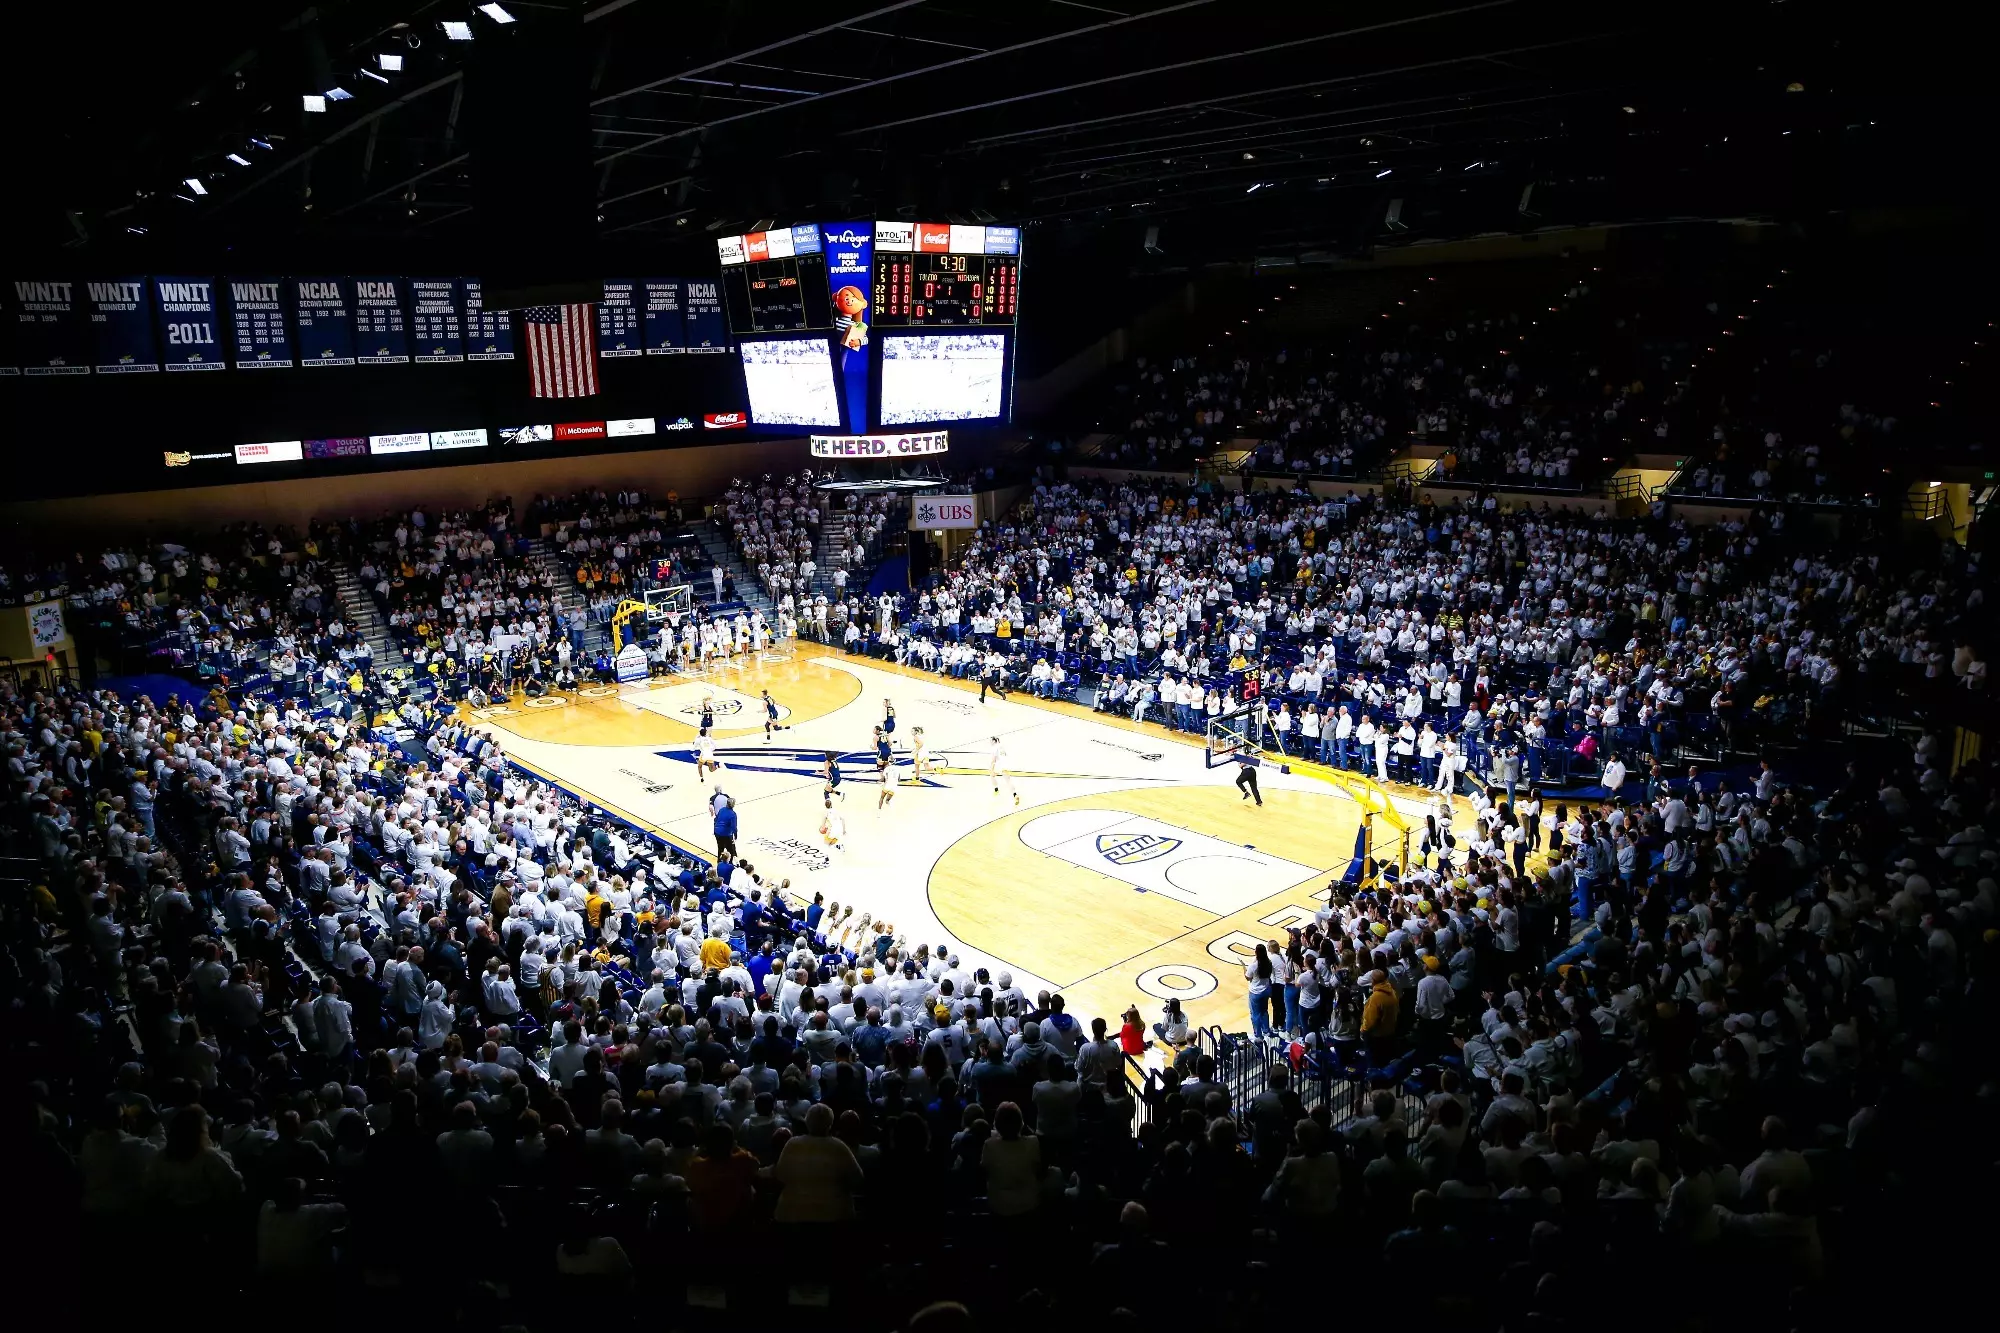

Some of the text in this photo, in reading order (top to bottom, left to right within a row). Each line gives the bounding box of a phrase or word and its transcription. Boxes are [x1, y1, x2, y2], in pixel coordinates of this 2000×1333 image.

[839, 229, 870, 248] Kroger
[877, 231, 900, 239] WTOL
[940, 256, 966, 272] 9:30
[15, 282, 72, 302] WNIT
[87, 283, 140, 302] WNIT
[159, 283, 209, 302] WNIT
[231, 283, 279, 302] WNIT
[299, 282, 340, 299] NCAA
[357, 282, 396, 298] NCAA
[688, 284, 717, 298] NCAA
[875, 285, 886, 293] 22
[925, 283, 934, 298] 0
[973, 283, 981, 298] 0
[875, 295, 885, 304] 33
[164, 304, 211, 312] CHAMPIONS
[416, 306, 454, 314] CHAMPIONS
[875, 306, 885, 315] 34
[168, 323, 214, 344] 2011
[568, 426, 602, 435] McDonald's
[666, 420, 694, 430] valpak
[336, 445, 366, 455] SIGN
[898, 437, 933, 452] GET
[939, 504, 972, 520] UBS
